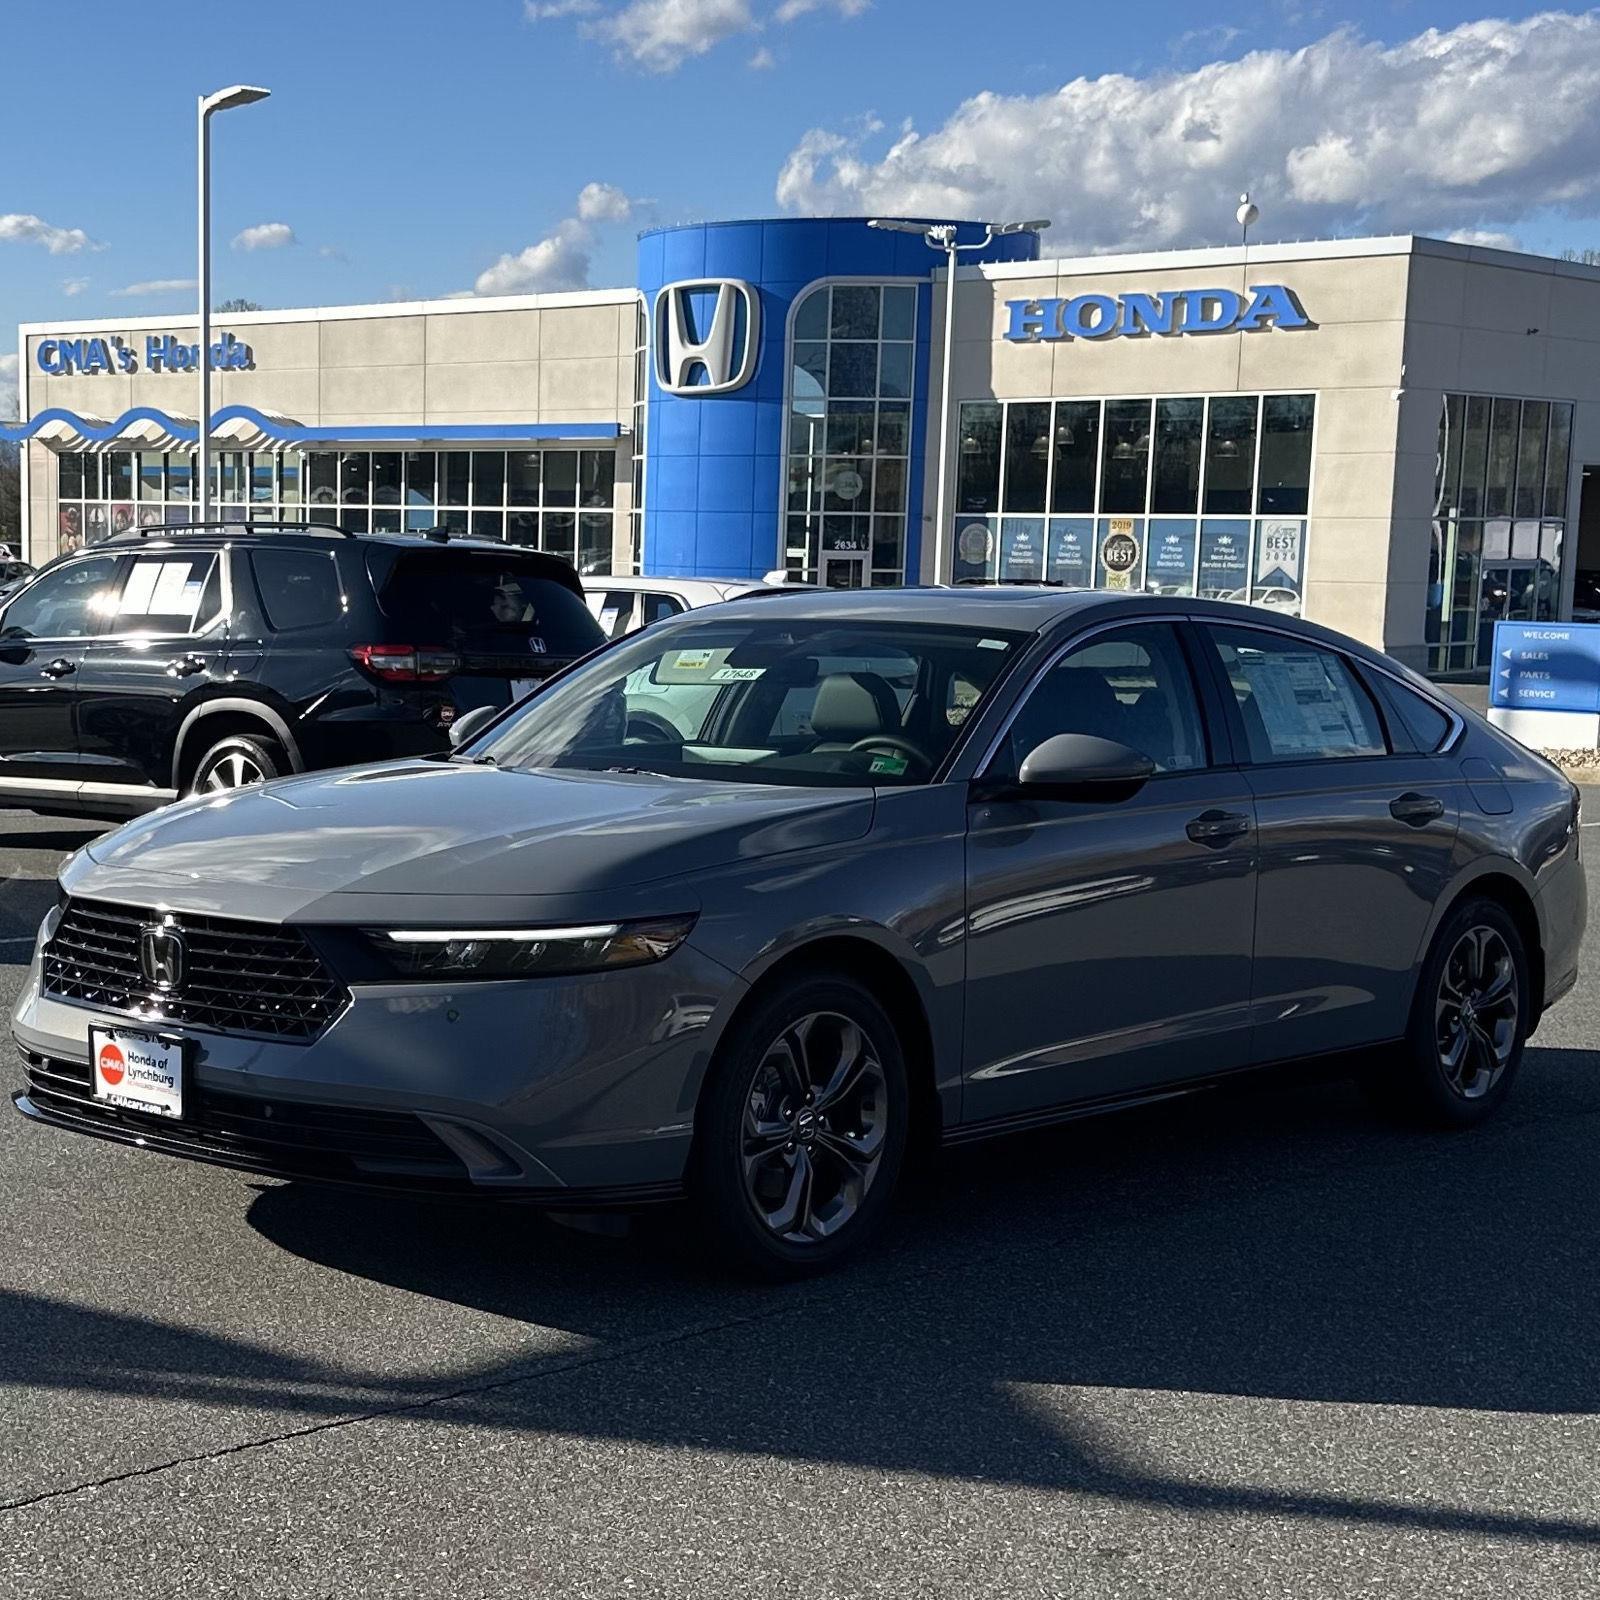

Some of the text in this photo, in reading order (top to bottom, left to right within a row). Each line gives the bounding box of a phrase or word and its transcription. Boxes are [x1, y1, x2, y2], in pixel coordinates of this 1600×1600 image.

[1003, 284, 1309, 341] HONDA
[37, 335, 135, 374] CMA's
[1111, 521, 1132, 530] 2019
[1266, 537, 1296, 549] BEST
[1106, 548, 1133, 562] BEST
[1265, 551, 1296, 562] 2020
[1522, 631, 1570, 640] WELCOME
[1520, 651, 1549, 660] SALES
[1519, 670, 1551, 680] PARTS
[1518, 689, 1556, 699] SERVICE
[127, 1050, 168, 1070] Honda of
[127, 1066, 174, 1088] Lynchburg
